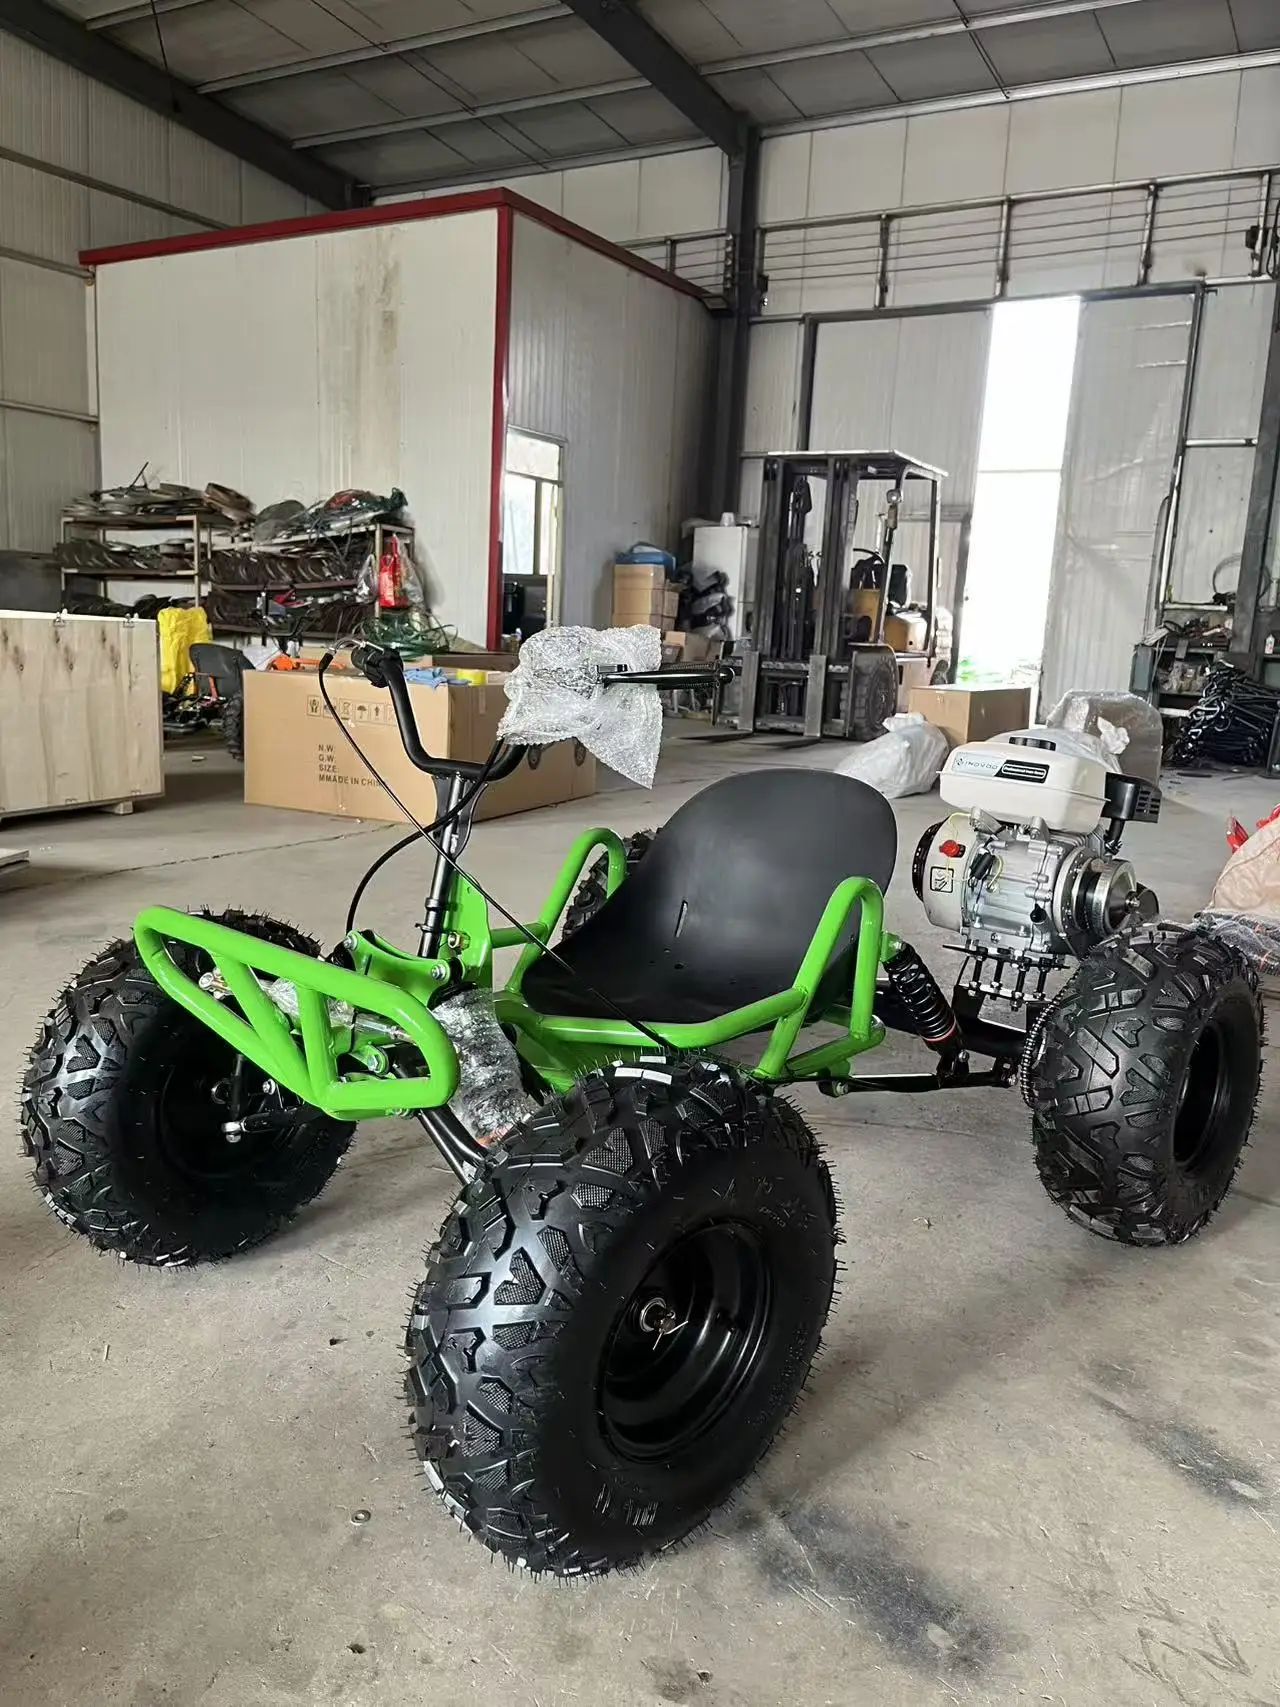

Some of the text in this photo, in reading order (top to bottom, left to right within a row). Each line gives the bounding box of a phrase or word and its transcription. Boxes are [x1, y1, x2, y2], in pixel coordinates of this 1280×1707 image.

[319, 774, 386, 788] MMADE IN CHI
